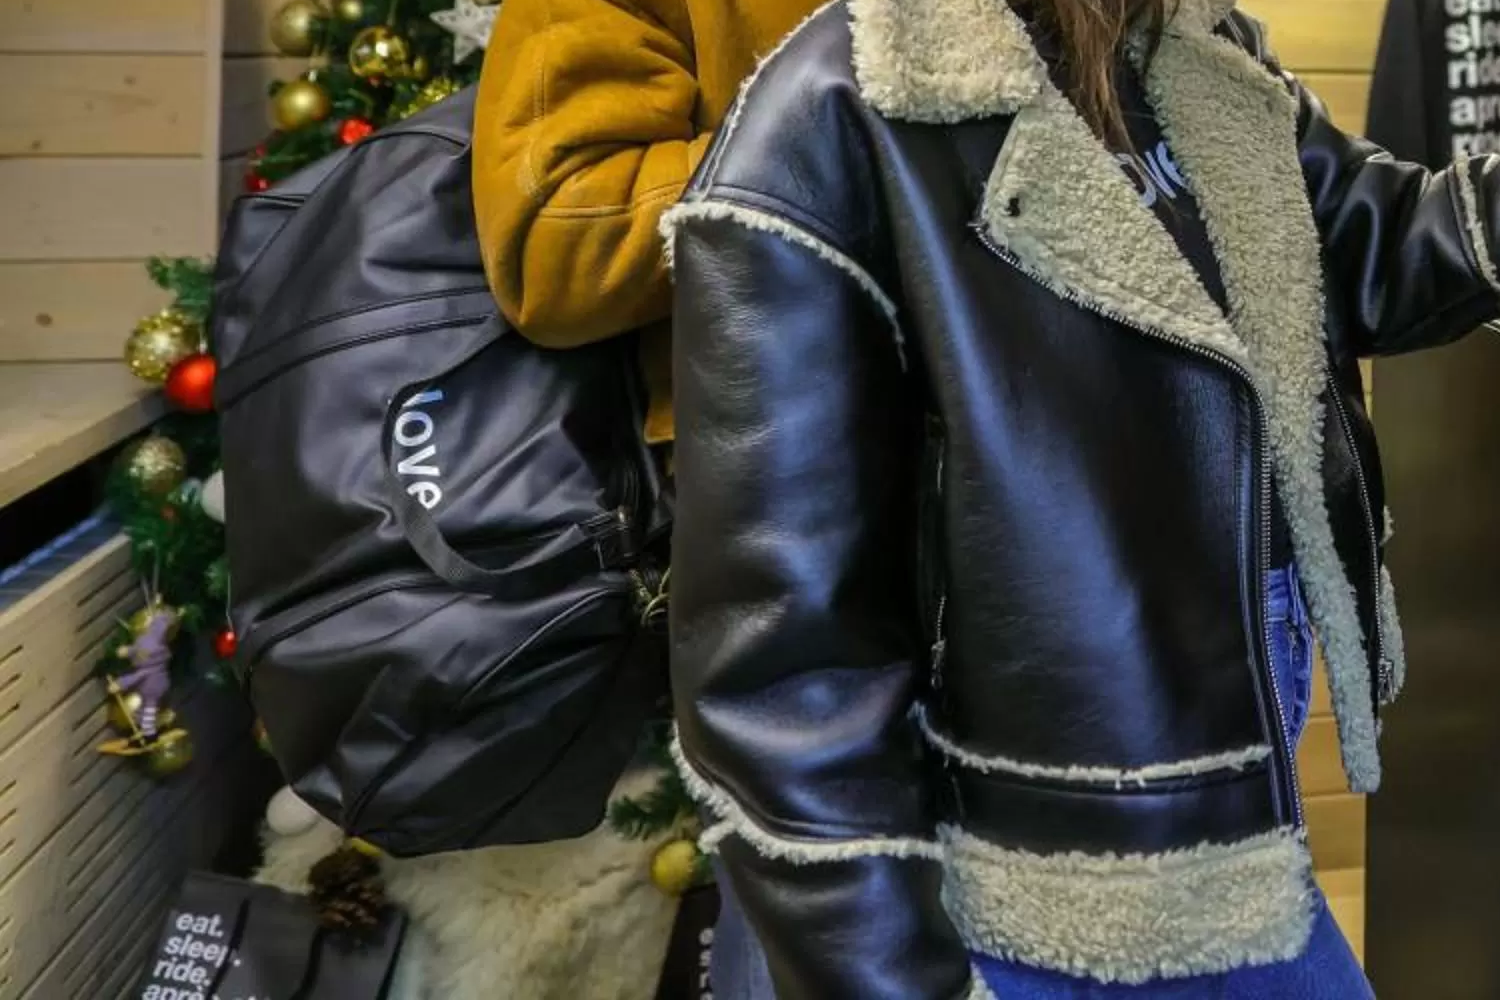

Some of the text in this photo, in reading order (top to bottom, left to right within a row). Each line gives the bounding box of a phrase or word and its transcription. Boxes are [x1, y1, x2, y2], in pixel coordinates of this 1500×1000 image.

[388, 389, 444, 510] love
[176, 912, 224, 938] eat.
[153, 956, 211, 986] ride.
